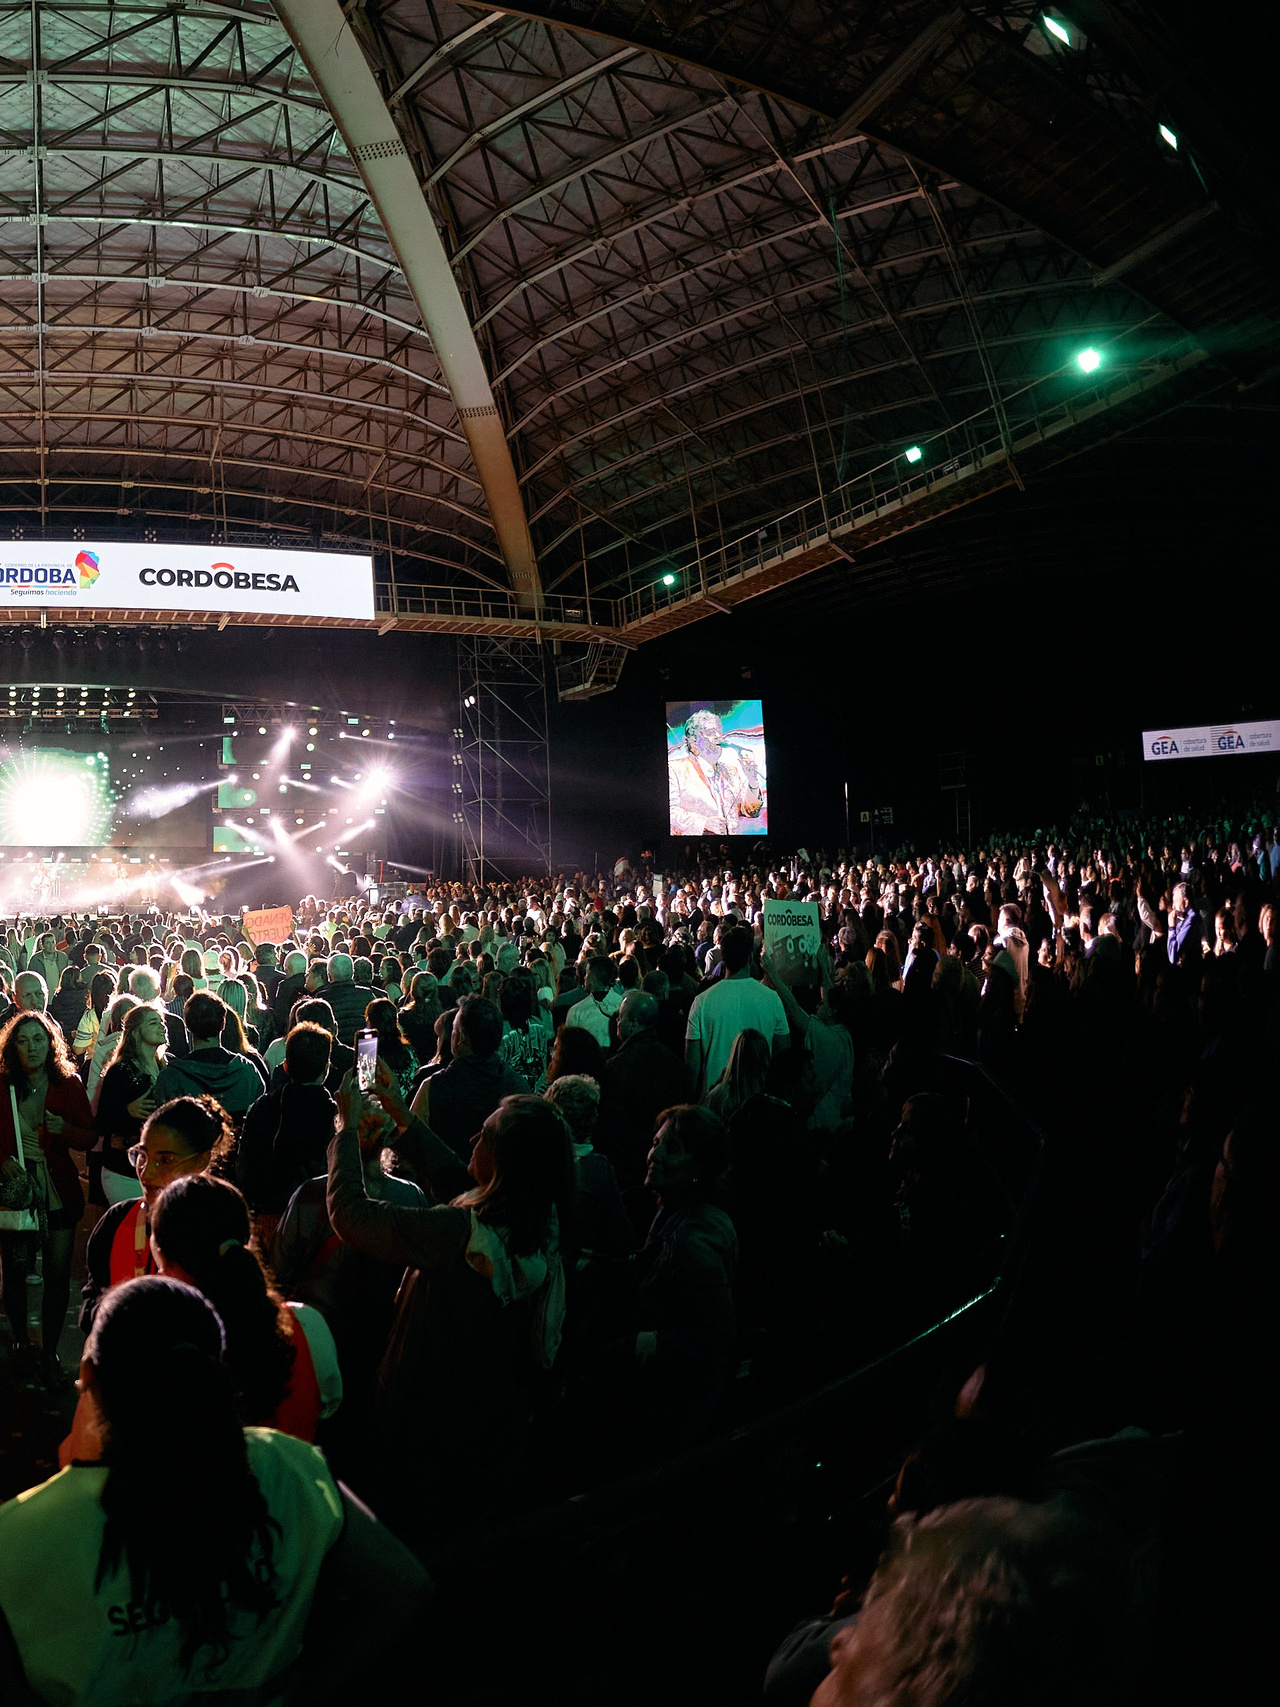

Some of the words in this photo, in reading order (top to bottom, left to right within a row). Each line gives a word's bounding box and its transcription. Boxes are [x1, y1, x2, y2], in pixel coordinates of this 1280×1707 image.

[10, 589, 44, 597] Seguimos
[1151, 740, 1179, 755] GEA
[1218, 735, 1245, 750] GEA
